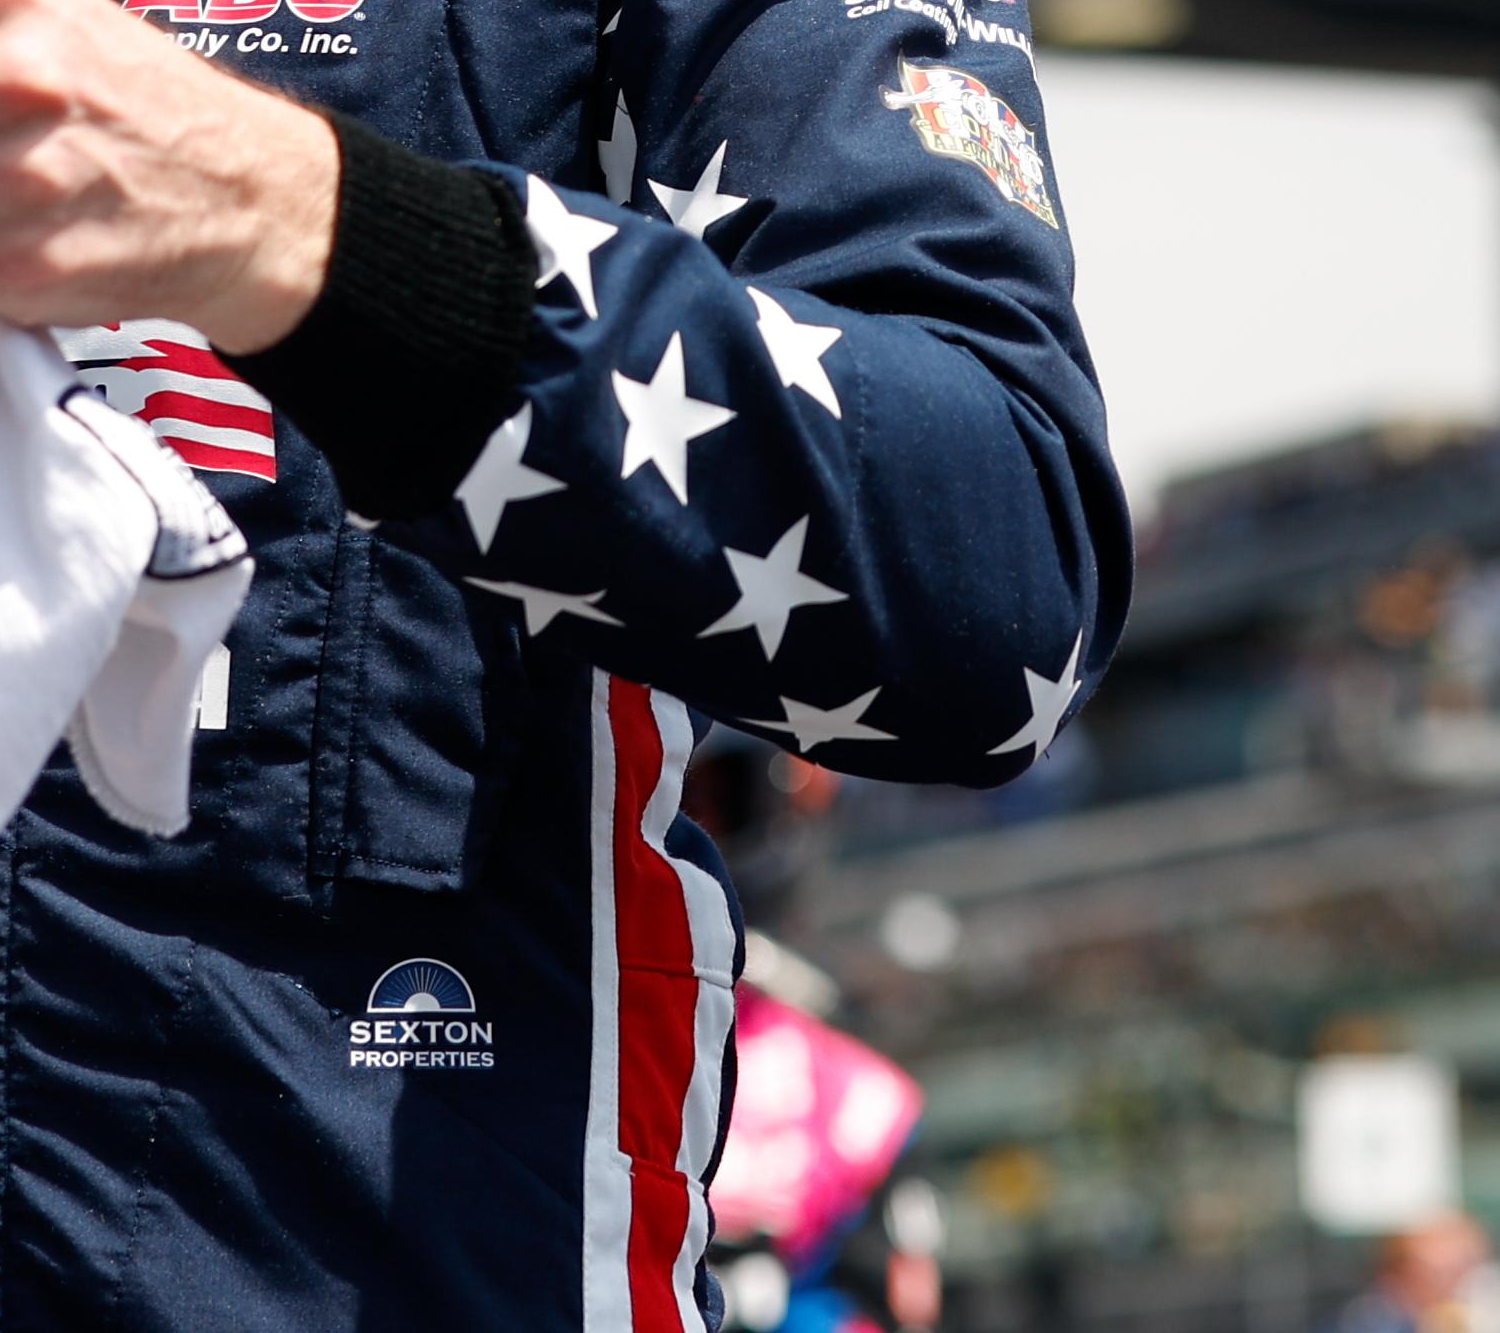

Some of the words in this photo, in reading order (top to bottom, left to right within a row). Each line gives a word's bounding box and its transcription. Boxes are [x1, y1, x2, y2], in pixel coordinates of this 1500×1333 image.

[236, 27, 290, 53] Co.
[300, 27, 358, 55] inc.
[350, 1020, 493, 1044] SEXTON
[350, 1050, 495, 1068] PROPERTIES
